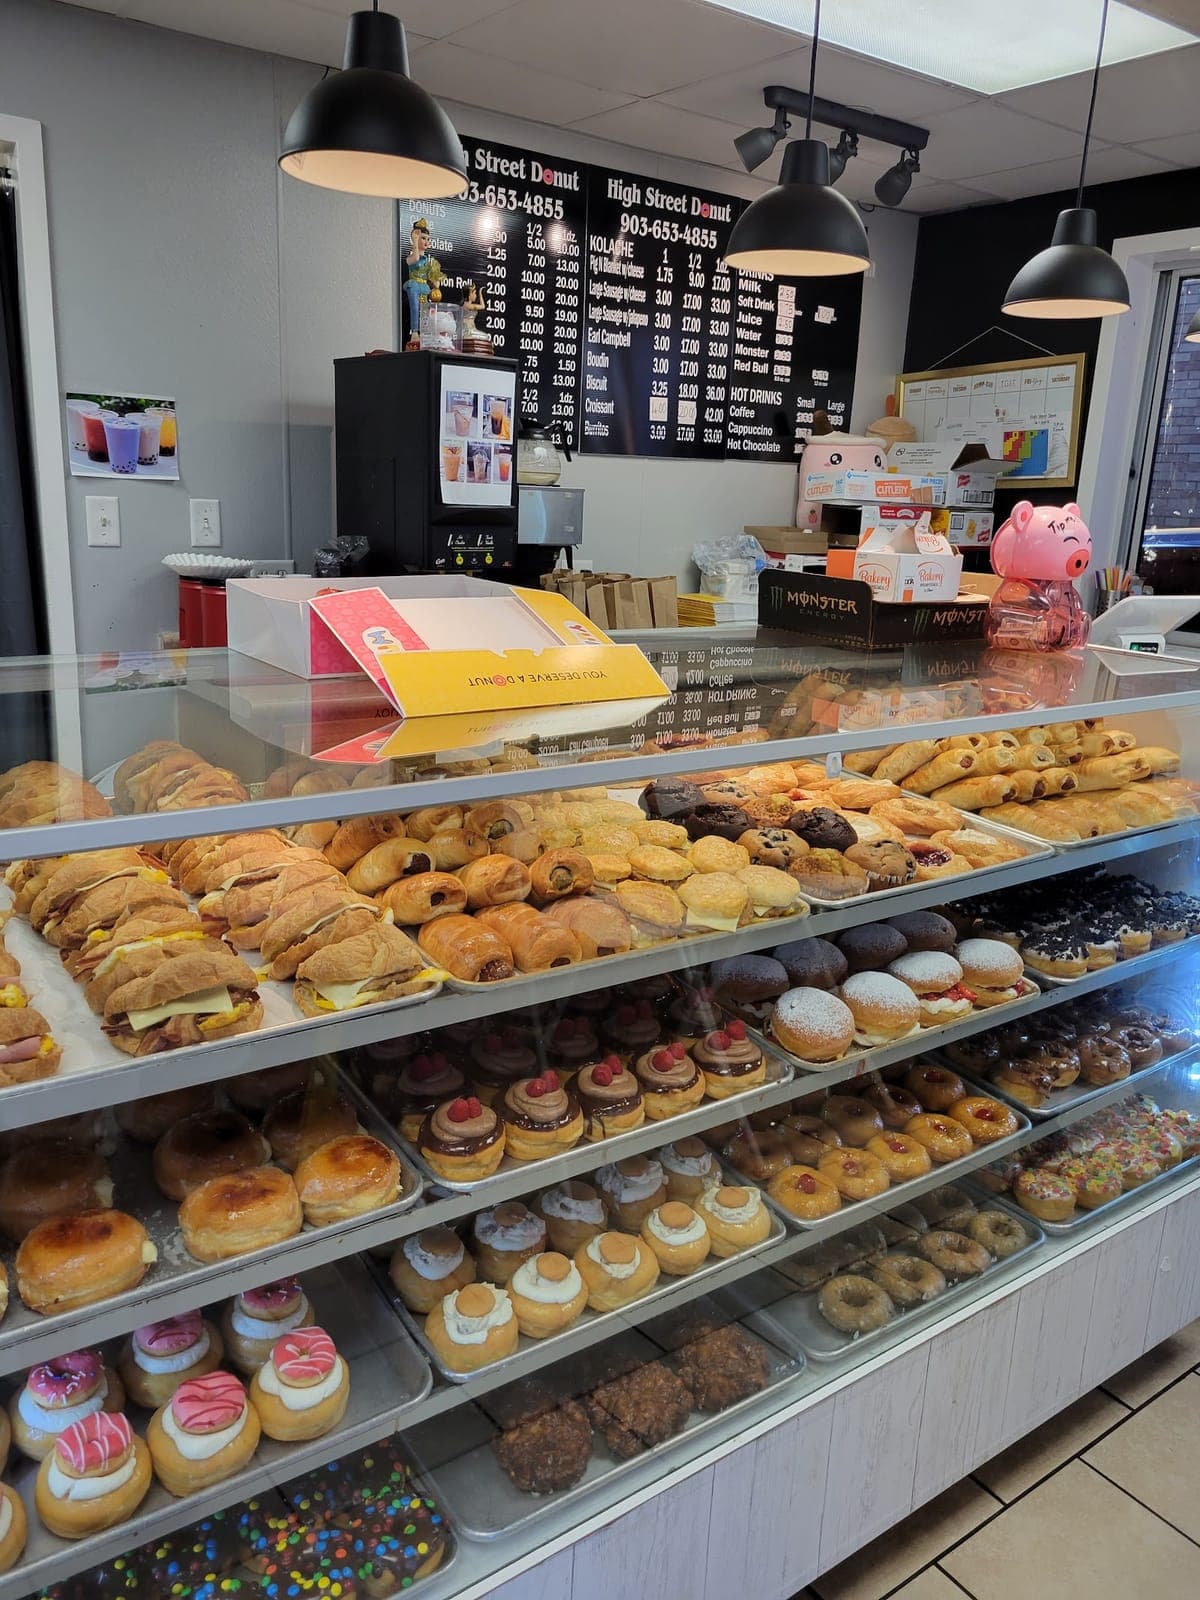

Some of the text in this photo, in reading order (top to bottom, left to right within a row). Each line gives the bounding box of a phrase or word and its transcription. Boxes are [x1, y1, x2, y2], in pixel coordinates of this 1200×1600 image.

[475, 148, 526, 179] Street
[531, 160, 580, 191] Donut
[607, 178, 732, 223] High Street Donut
[526, 222, 543, 237] 1/2
[620, 213, 718, 249] 903-653-4855
[527, 236, 546, 251] 5.00
[590, 234, 634, 258] KOLACHE
[487, 247, 507, 261] 1.25
[527, 254, 546, 268] 7.00
[556, 259, 580, 274] 13.00
[662, 247, 669, 264] 1
[688, 252, 702, 272] 1/2
[486, 264, 579, 290] 2.00 10.00 20.00
[656, 266, 674, 284] 1.75
[688, 271, 705, 288] 9.00
[711, 275, 731, 292] 17.00
[738, 278, 762, 293] Milk
[486, 282, 507, 297] 2.00
[521, 287, 545, 302] 10.00
[555, 292, 578, 307] 20.00
[603, 280, 624, 303] Sausage
[655, 288, 673, 306] 3.00
[682, 293, 702, 311] 17.00
[710, 297, 731, 315] 33.00
[737, 294, 754, 309] Soft
[754, 297, 775, 312] Drink
[486, 299, 578, 323] 1.90 9.50 19.00
[736, 311, 763, 326] Juice
[486, 316, 577, 340] 2.00 10.00 20.00
[602, 304, 623, 326] Sausage
[654, 311, 671, 330] 3.00
[681, 315, 701, 333] 17.00
[709, 319, 730, 337] 33.00
[588, 326, 729, 358] Earl Campbell 3.00 17.00 33.00
[736, 327, 762, 342] Water
[519, 338, 543, 352] 10.00
[553, 342, 577, 356] 20.00
[735, 343, 770, 359] Monster
[524, 355, 576, 372] .75 1.50
[586, 350, 727, 380] Boudin 3.00 17.00 33.00
[734, 359, 751, 372] Red
[752, 361, 769, 375] Bull
[521, 371, 575, 388] 7.00 13.00
[586, 374, 726, 402] Biscuit 3.25 18.00 36.00
[522, 388, 538, 402] 1/2
[730, 386, 783, 406] HOT DRINKS
[521, 401, 574, 417] 7.00 13.00
[585, 398, 615, 415] Croissant
[704, 407, 724, 423] 42.00
[729, 405, 756, 419] Coffee
[796, 396, 846, 414] Small Large
[584, 420, 609, 437] Burritos
[650, 424, 666, 440] 3.00
[676, 427, 695, 442] 17.00
[703, 428, 723, 444] 33.00
[728, 422, 773, 437] Cappuccino
[551, 433, 573, 446] 13.0
[727, 438, 741, 451] Hot
[742, 439, 781, 453] Chocolate
[876, 485, 909, 495] CUTLERY
[1048, 520, 1065, 535] Tip
[860, 568, 892, 592] Bakery
[918, 568, 944, 587] Bakery
[787, 590, 858, 615] MONSTER
[800, 608, 846, 621] ENERGY
[932, 609, 987, 625] MONST
[468, 670, 608, 687] YOU DESERVE A DONUT
